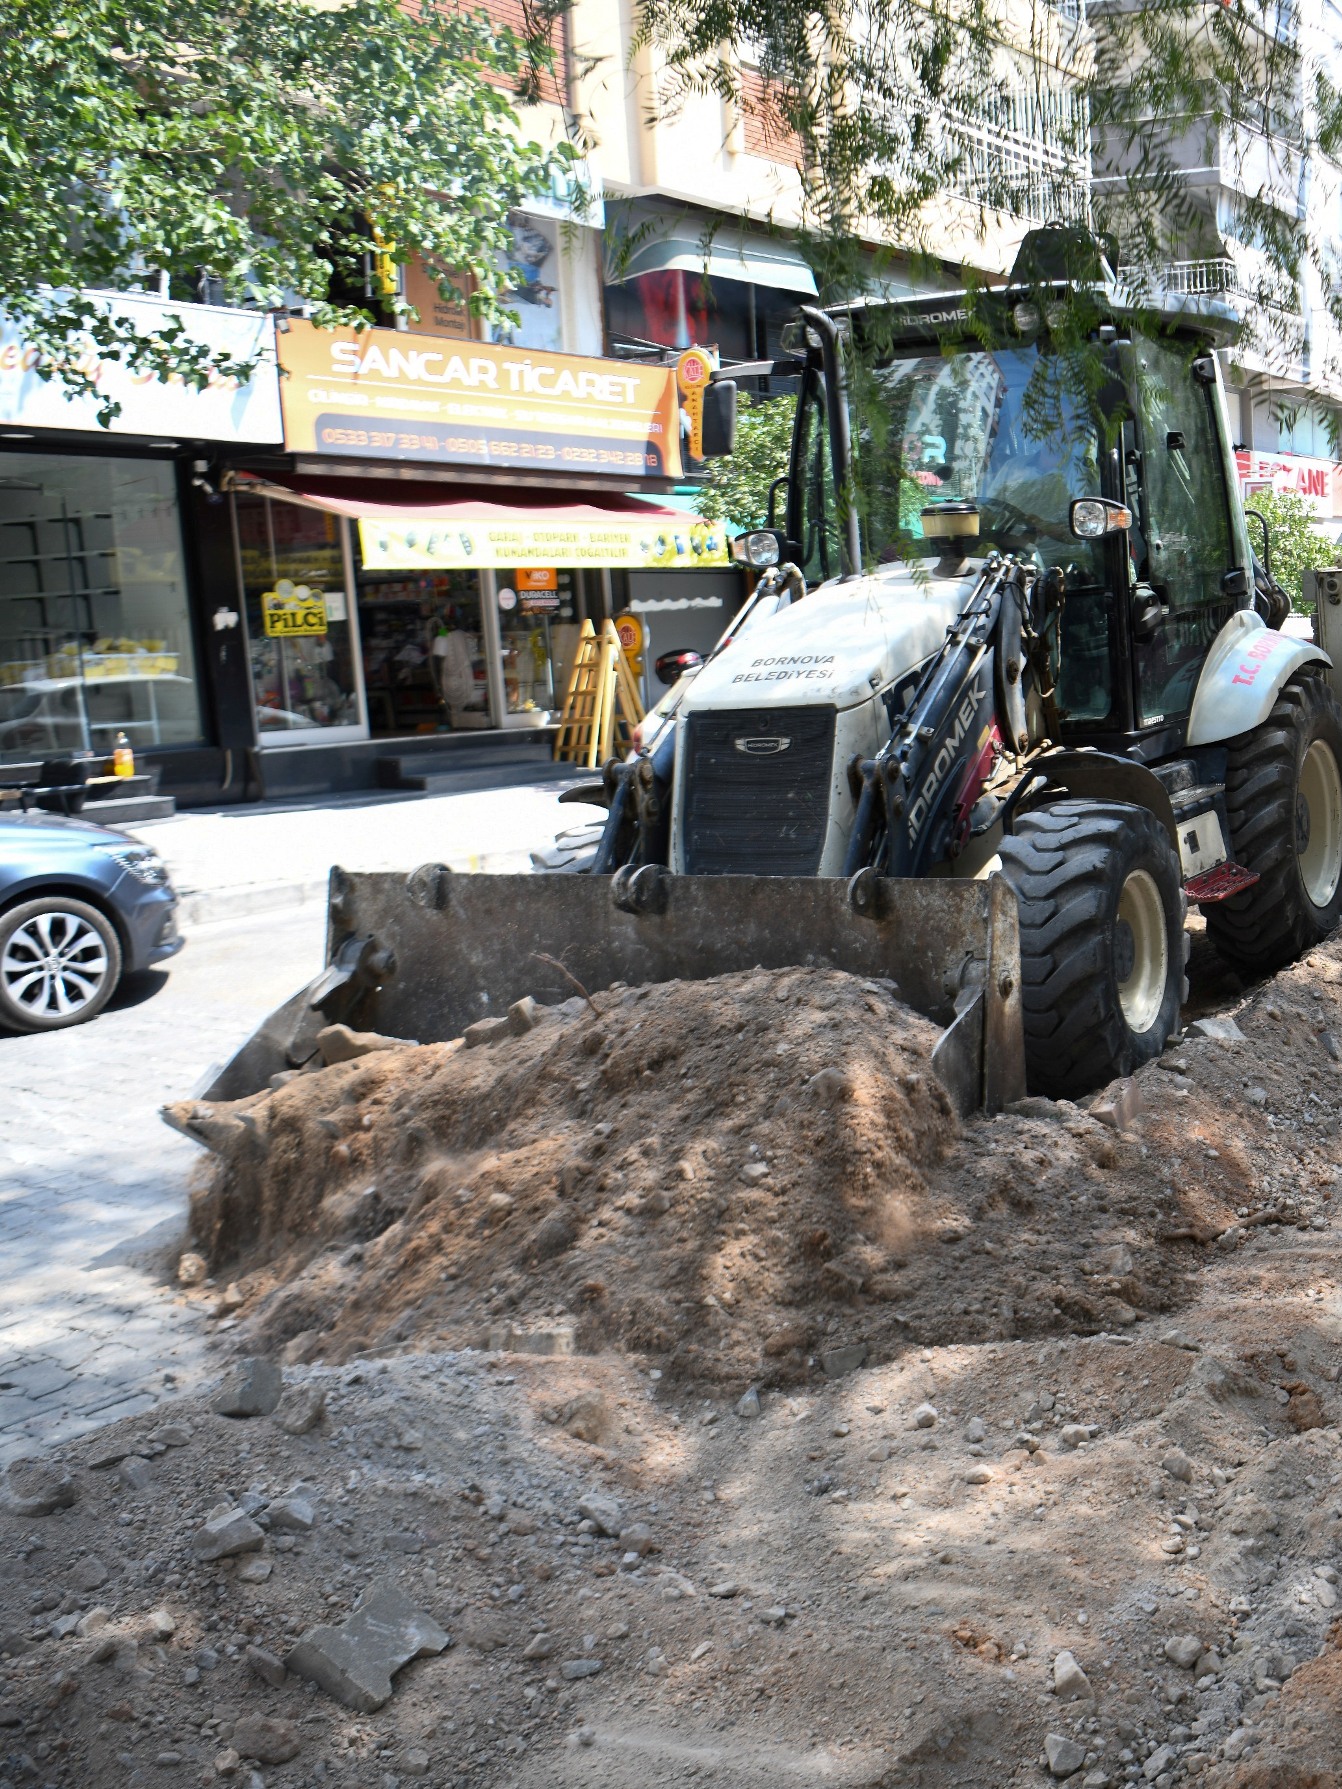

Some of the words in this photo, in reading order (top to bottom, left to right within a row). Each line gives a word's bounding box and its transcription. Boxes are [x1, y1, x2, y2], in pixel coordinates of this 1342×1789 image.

[330, 341, 500, 389] SANCAR
[503, 360, 641, 404] TİCARET
[322, 427, 368, 446] 0533
[561, 447, 597, 462] 0232
[520, 590, 558, 599] DURACELL
[750, 655, 836, 668] BORNOVA
